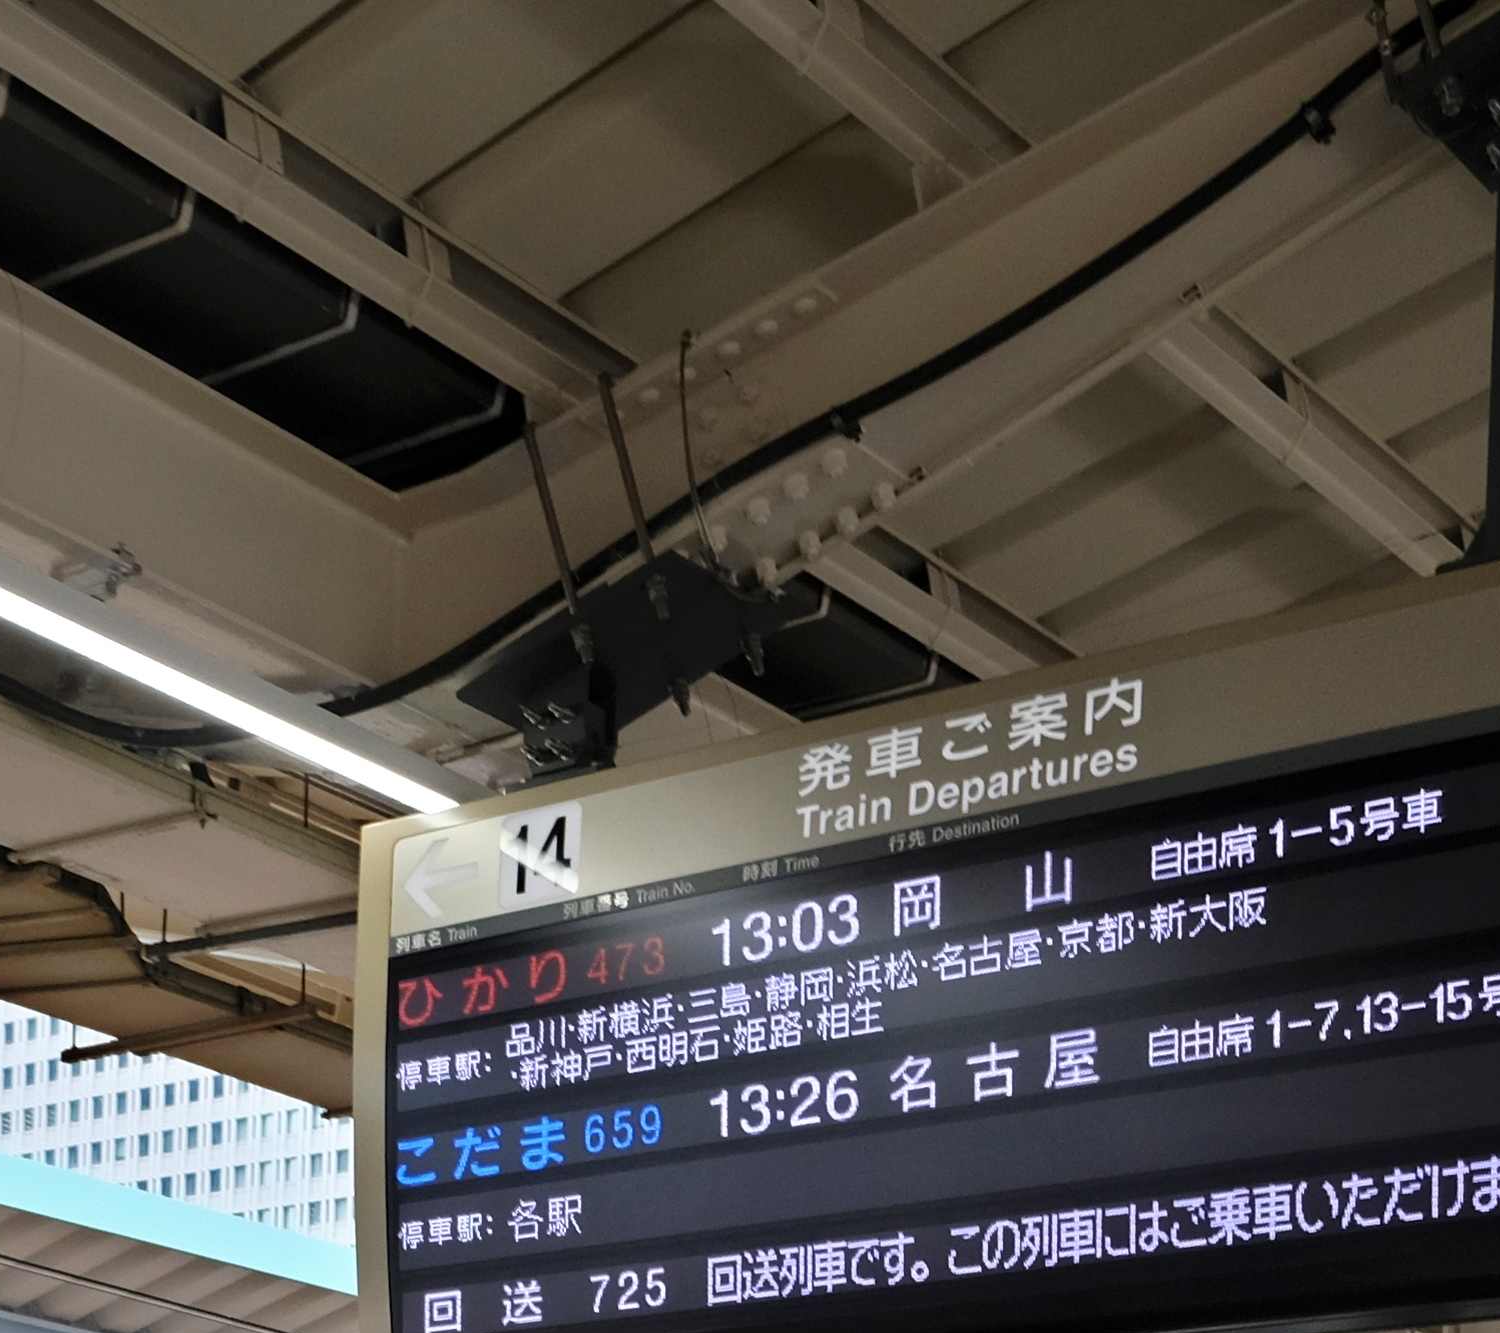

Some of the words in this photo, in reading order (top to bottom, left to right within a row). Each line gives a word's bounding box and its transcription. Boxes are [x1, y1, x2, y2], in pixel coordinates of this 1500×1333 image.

[798, 677, 1143, 797] 発車ご案内
[796, 794, 892, 839] Train
[908, 742, 1138, 816] Departures
[514, 815, 572, 895] 14
[889, 831, 927, 853] 行先
[932, 812, 1020, 843] Destination
[742, 862, 779, 882] 時刻
[785, 854, 820, 871] Time
[563, 891, 630, 920] 列車番号
[636, 886, 669, 905] Train
[673, 880, 697, 897] No.
[396, 930, 443, 955] 列車名
[448, 923, 478, 942] Train
[398, 950, 567, 1026] ひかり
[587, 935, 666, 985] 473
[711, 893, 861, 967] 13:03
[396, 1116, 566, 1186] こだま
[584, 1104, 664, 1154] 659
[709, 1070, 860, 1138] 13:26
[508, 1195, 582, 1243] 各駅
[590, 1267, 667, 1314] 725
